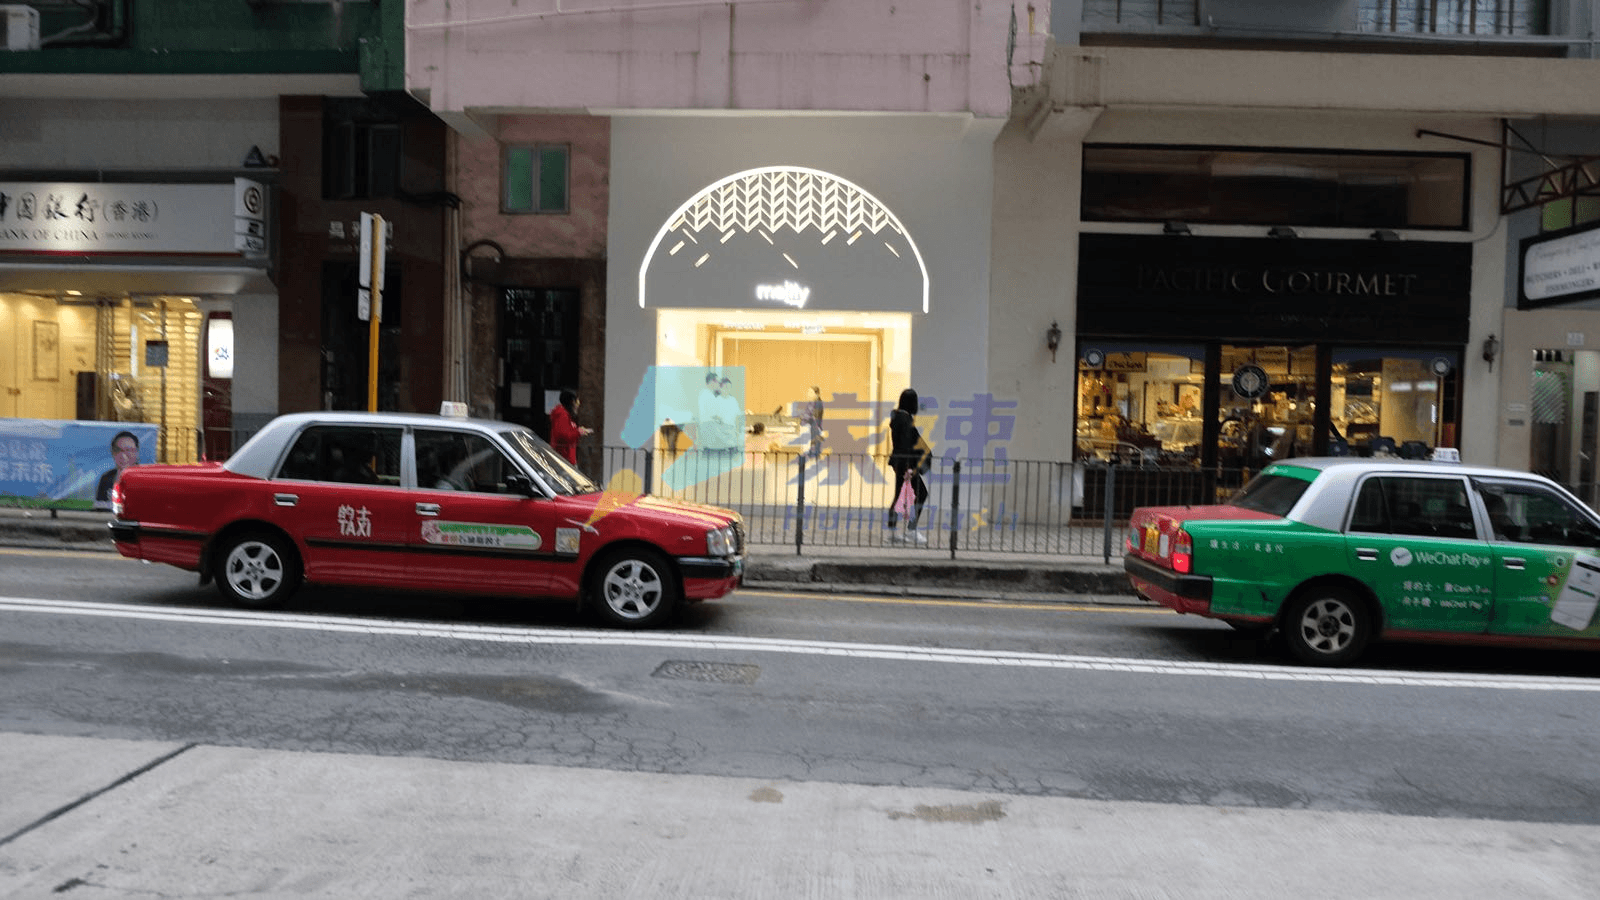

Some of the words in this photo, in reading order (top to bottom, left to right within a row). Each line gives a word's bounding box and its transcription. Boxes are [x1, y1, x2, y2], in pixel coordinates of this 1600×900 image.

[54, 229, 99, 241] CHINA
[1136, 264, 1251, 293] PACIFIC
[1262, 268, 1417, 297] GOURMET
[337, 504, 372, 521] 的士
[337, 519, 372, 538] TAXI
[1415, 551, 1461, 566] WeChat
